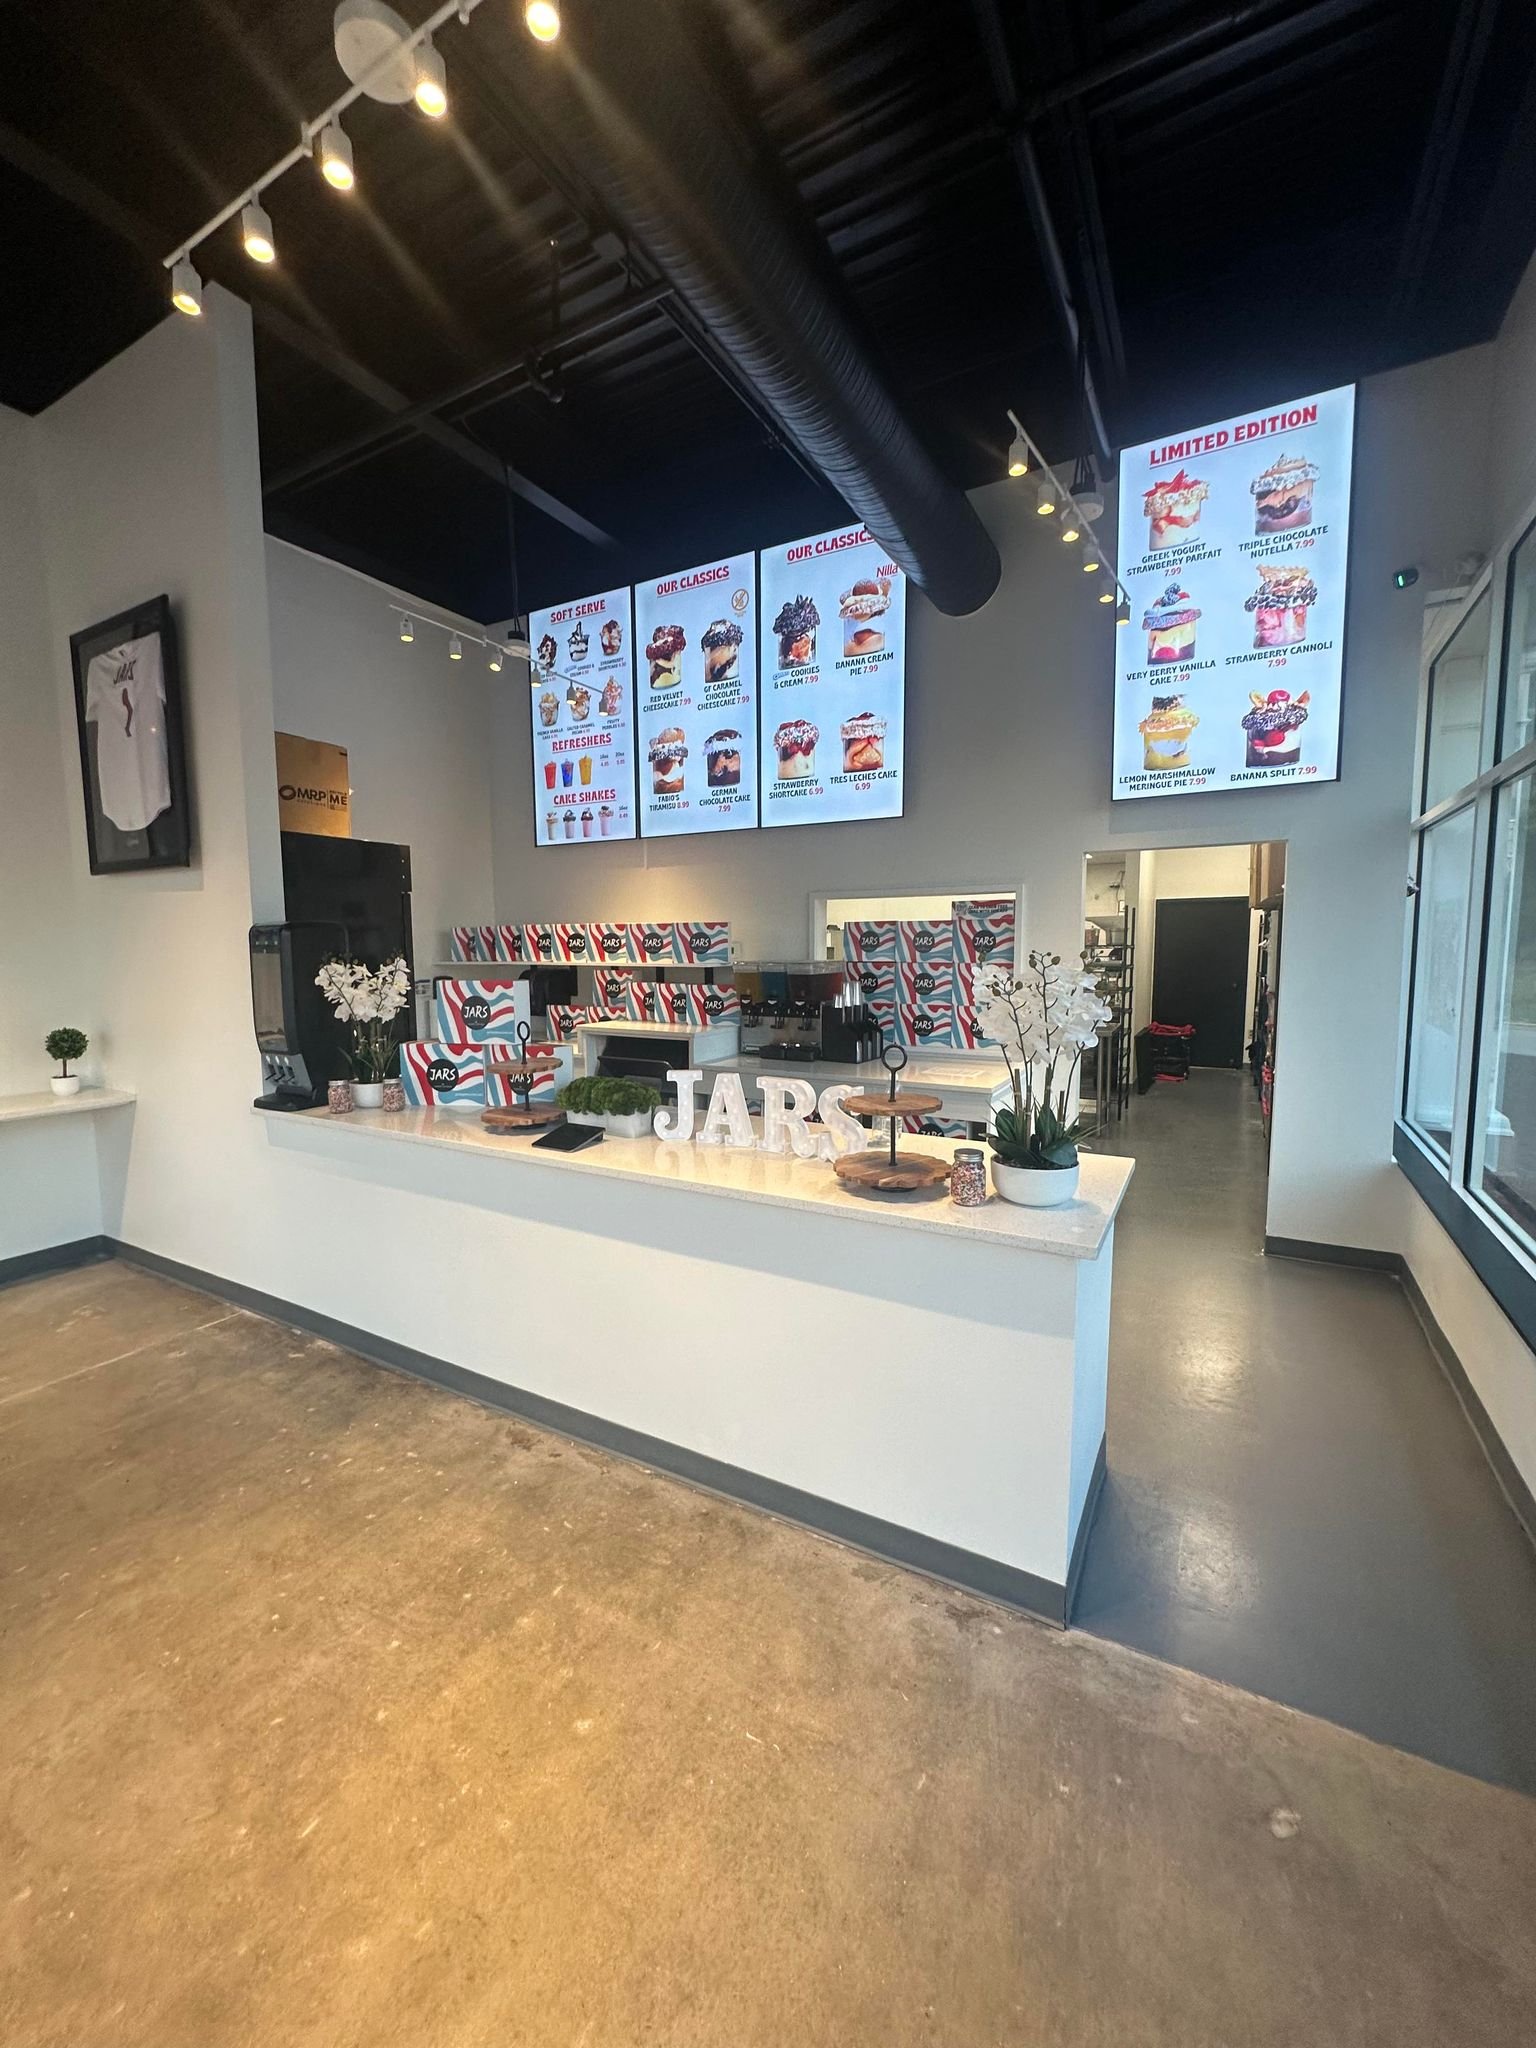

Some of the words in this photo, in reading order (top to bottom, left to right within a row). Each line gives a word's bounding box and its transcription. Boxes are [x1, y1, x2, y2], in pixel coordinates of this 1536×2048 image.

[1150, 430, 1229, 465] LIMITED
[1234, 404, 1317, 442] EDITION
[1238, 538, 1271, 552] TRIPLE
[1273, 525, 1328, 544] CHOCOLATE
[787, 544, 812, 561] OUR
[1141, 551, 1170, 564] GREEK
[1172, 543, 1206, 557] YOGURT
[1250, 543, 1293, 559] NUTELLA
[1295, 538, 1315, 550] 7.99
[1126, 558, 1183, 576] STRAWBERRY
[1185, 549, 1222, 564] PARFAIT
[1164, 567, 1181, 577] 7.99
[657, 581, 677, 595] OUR
[680, 566, 729, 588] CLASSICS
[551, 608, 572, 622] SOFT
[576, 599, 605, 616] SERVE
[1225, 649, 1288, 666] STRAWBERRY
[1290, 641, 1333, 655] CANNOLI
[835, 658, 865, 669] BANANA
[868, 652, 894, 663] CREAM
[1267, 658, 1286, 668] 7.99
[791, 666, 819, 677] COOKIES
[850, 668, 862, 676] PIE
[863, 665, 878, 673] 7.99
[1126, 671, 1147, 681] VERY
[1150, 667, 1177, 677] BERRY
[1179, 660, 1216, 673] VANILLA
[713, 680, 742, 691] CARAMEL
[780, 678, 803, 688] CREAM
[805, 675, 818, 684] 7.99
[1150, 675, 1171, 686] CAKE
[1173, 673, 1190, 683] 7.99
[662, 691, 683, 701] VELVET
[706, 689, 740, 701] CHOCOLATE
[643, 700, 678, 712] CHEESECAKE
[697, 698, 735, 710] CHEESECAKE
[737, 696, 750, 704] 7.99
[552, 733, 611, 751] REFRESHERS
[830, 776, 847, 784] TRES
[849, 772, 876, 781] LECHES
[878, 770, 897, 778] CAKE
[1119, 774, 1147, 784] LEMON
[1149, 768, 1216, 781] MARSHMALLOW
[1230, 771, 1268, 781] BANANA
[1270, 768, 1296, 778] SPLIT
[1298, 766, 1317, 776] 7.99
[773, 779, 818, 790] STRAWBERRY
[855, 782, 870, 790] 6.99
[1129, 780, 1172, 791] MERINGUE
[1174, 779, 1187, 787] PIE
[1189, 777, 1206, 786] 7.99
[297, 787, 326, 801] MRP
[330, 794, 347, 805] ME
[554, 794, 576, 805] CAKE
[580, 789, 615, 802] SHAKES
[712, 788, 737, 796] GERMAN
[769, 789, 807, 799] SHORTCAKE
[809, 787, 823, 795] 6.99
[658, 794, 679, 803] FABIO'S
[699, 797, 733, 806] CHOCOLATE
[649, 803, 676, 811] TIRAMISU
[569, 939, 584, 947] JARS
[603, 938, 619, 947] JARS
[644, 938, 662, 947] JARS
[691, 938, 709, 947] JARS
[861, 937, 877, 945] JARS
[915, 937, 932, 946] JARS
[974, 936, 994, 946] JARS
[607, 984, 619, 992] JARS
[861, 978, 877, 987] JARS
[915, 979, 932, 988] JARS
[673, 998, 686, 1007] JAR
[705, 1000, 722, 1010] JARS
[464, 1006, 488, 1018] JARS
[560, 1019, 572, 1027] JARS
[914, 1020, 932, 1029] JARS
[430, 1068, 455, 1081] JARS
[653, 1069, 868, 1162] JARS
